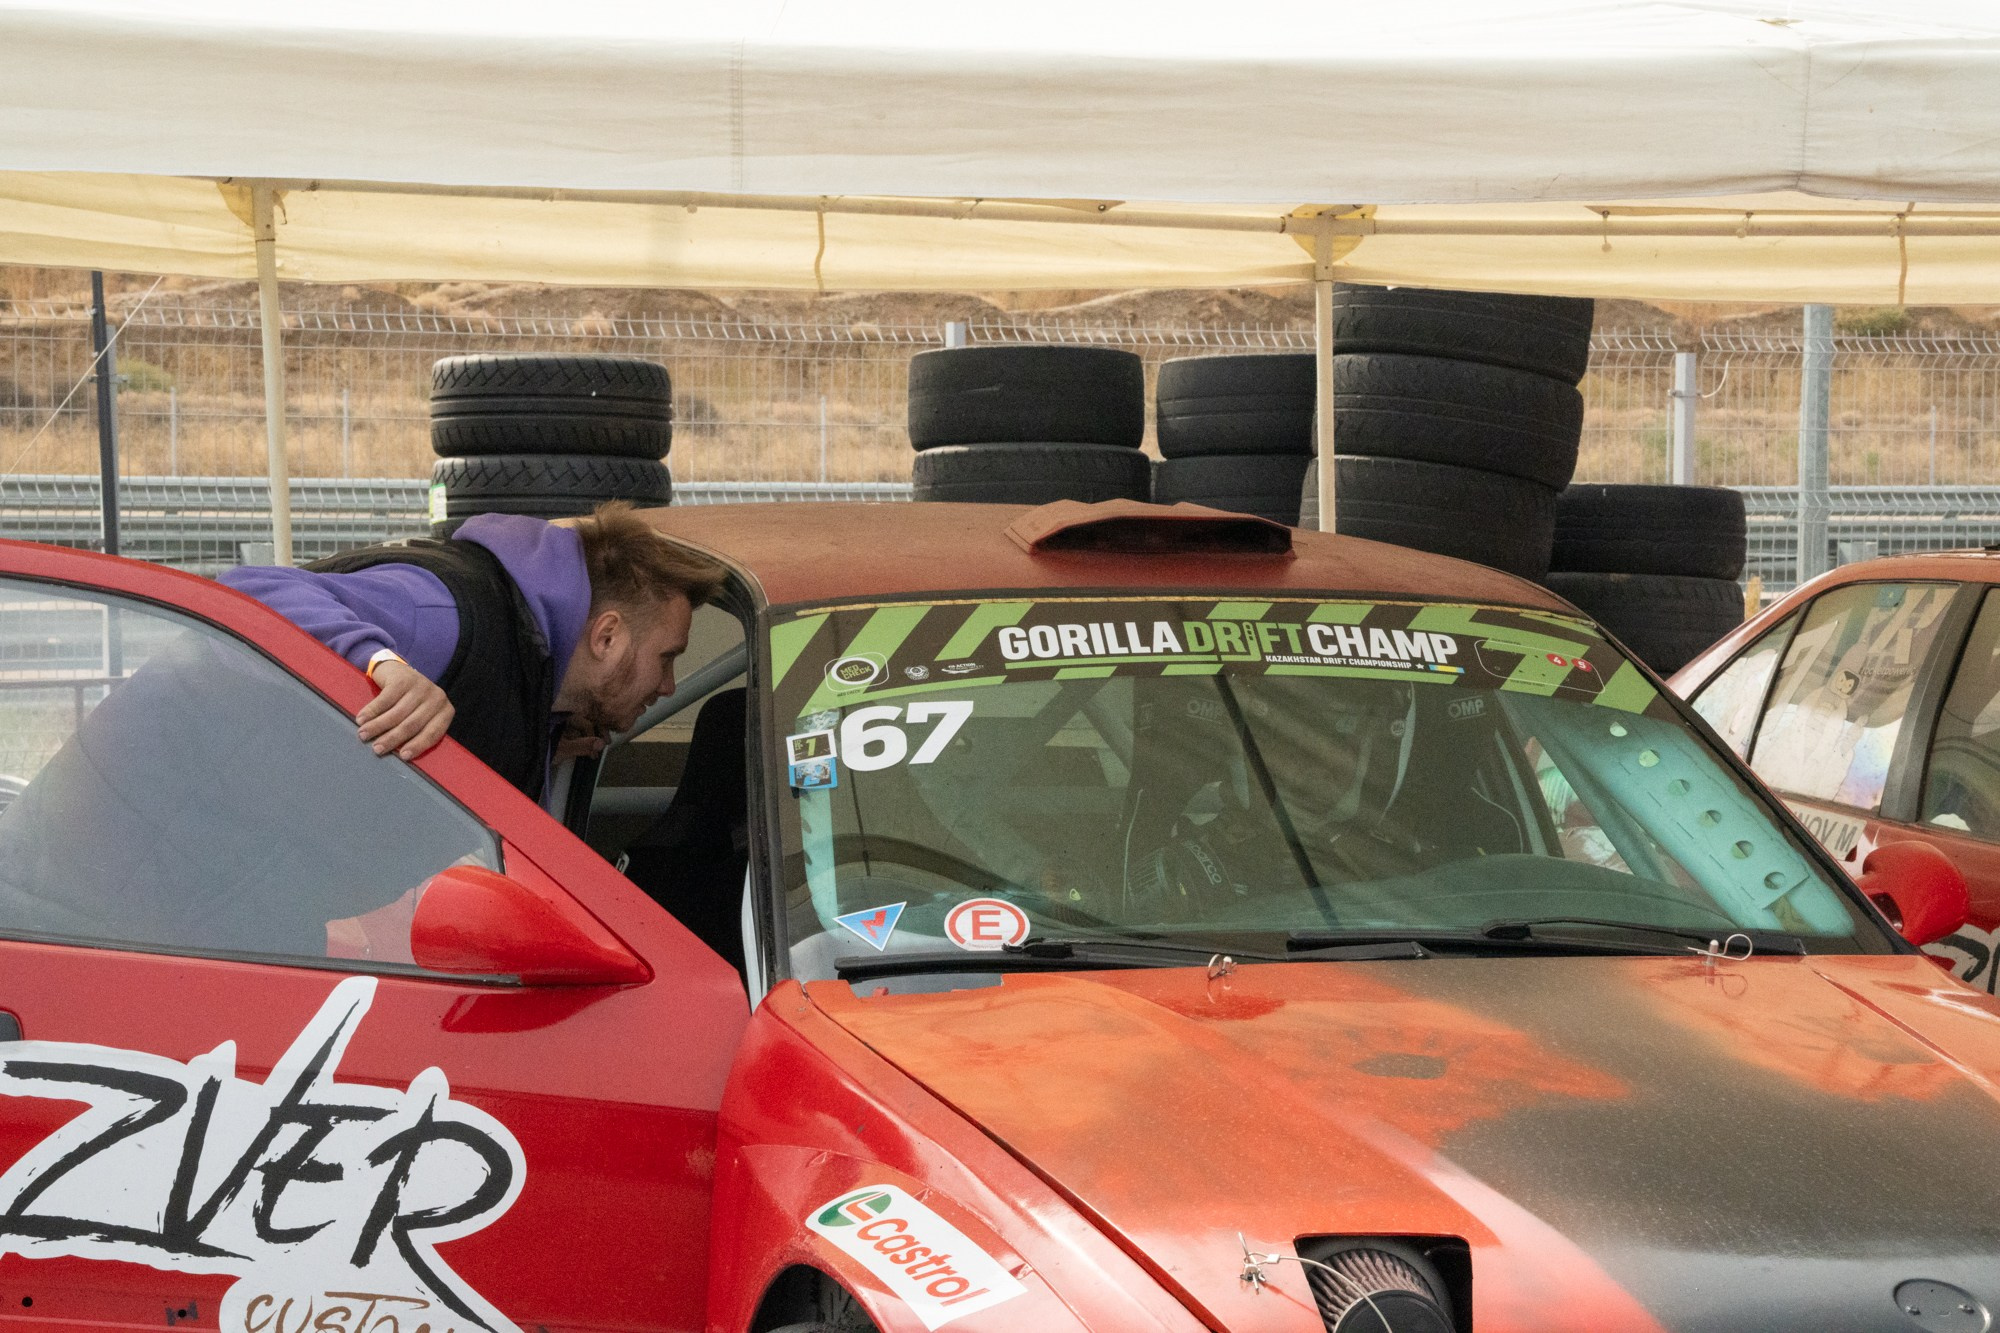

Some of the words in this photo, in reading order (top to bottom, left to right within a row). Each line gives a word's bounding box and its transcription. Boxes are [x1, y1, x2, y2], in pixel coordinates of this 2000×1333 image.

[998, 621, 1183, 660] GORILLA
[1183, 621, 1303, 661] DRIFT
[1306, 623, 1458, 664] CHAMP
[839, 664, 859, 675] MED
[843, 665, 872, 680] CHECK
[1265, 654, 1321, 664] KAZAKHSTAN
[1323, 656, 1346, 665] DRIFT
[1348, 658, 1412, 669] CHAMPIONSHIP
[1448, 698, 1485, 718] OMP
[806, 737, 817, 757] 1
[840, 700, 974, 772] 67
[1834, 823, 1858, 853] M
[971, 909, 1003, 941] E
[0, 999, 513, 1333] ZVER
[857, 1218, 991, 1307] Castrol
